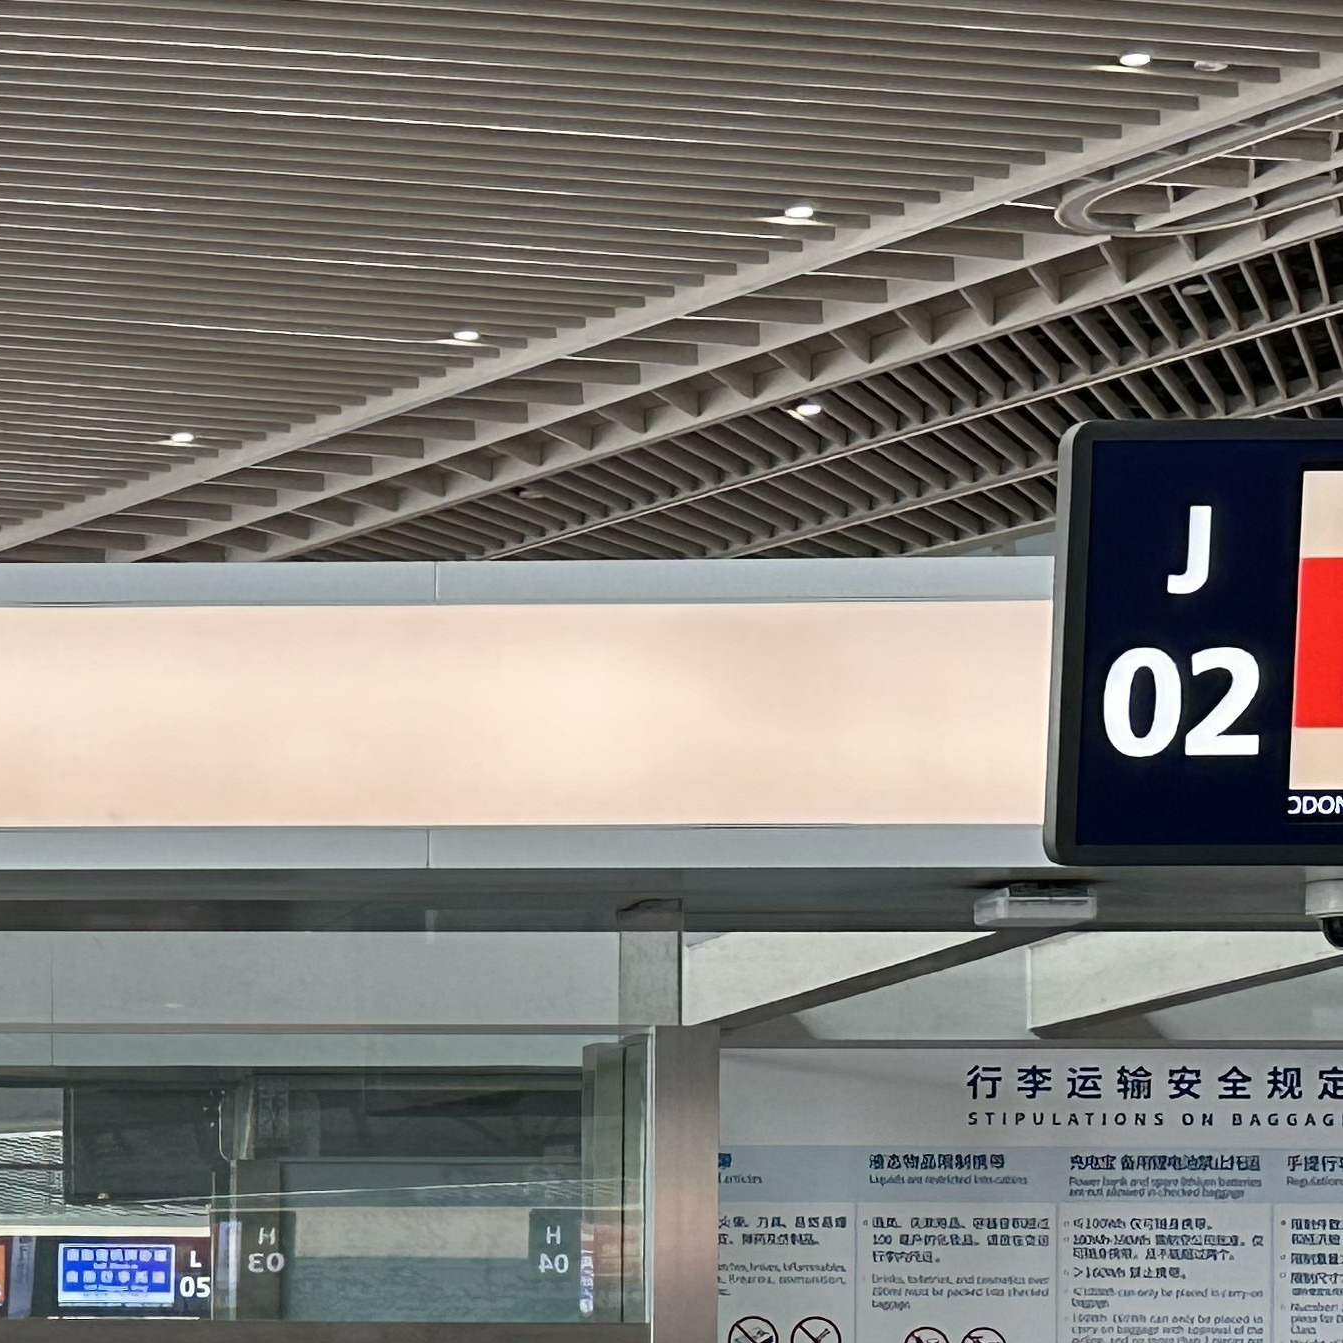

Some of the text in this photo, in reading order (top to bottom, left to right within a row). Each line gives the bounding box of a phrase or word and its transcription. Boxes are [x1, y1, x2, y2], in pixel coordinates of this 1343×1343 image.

[1167, 505, 1212, 594] J
[1103, 647, 1259, 757] 02
[966, 1065, 1343, 1100] 行李运输安全规定
[968, 1112, 1343, 1127] STIPULATIONS ON BAGGAG
[190, 1251, 202, 1268] L
[180, 1276, 211, 1299] 05
